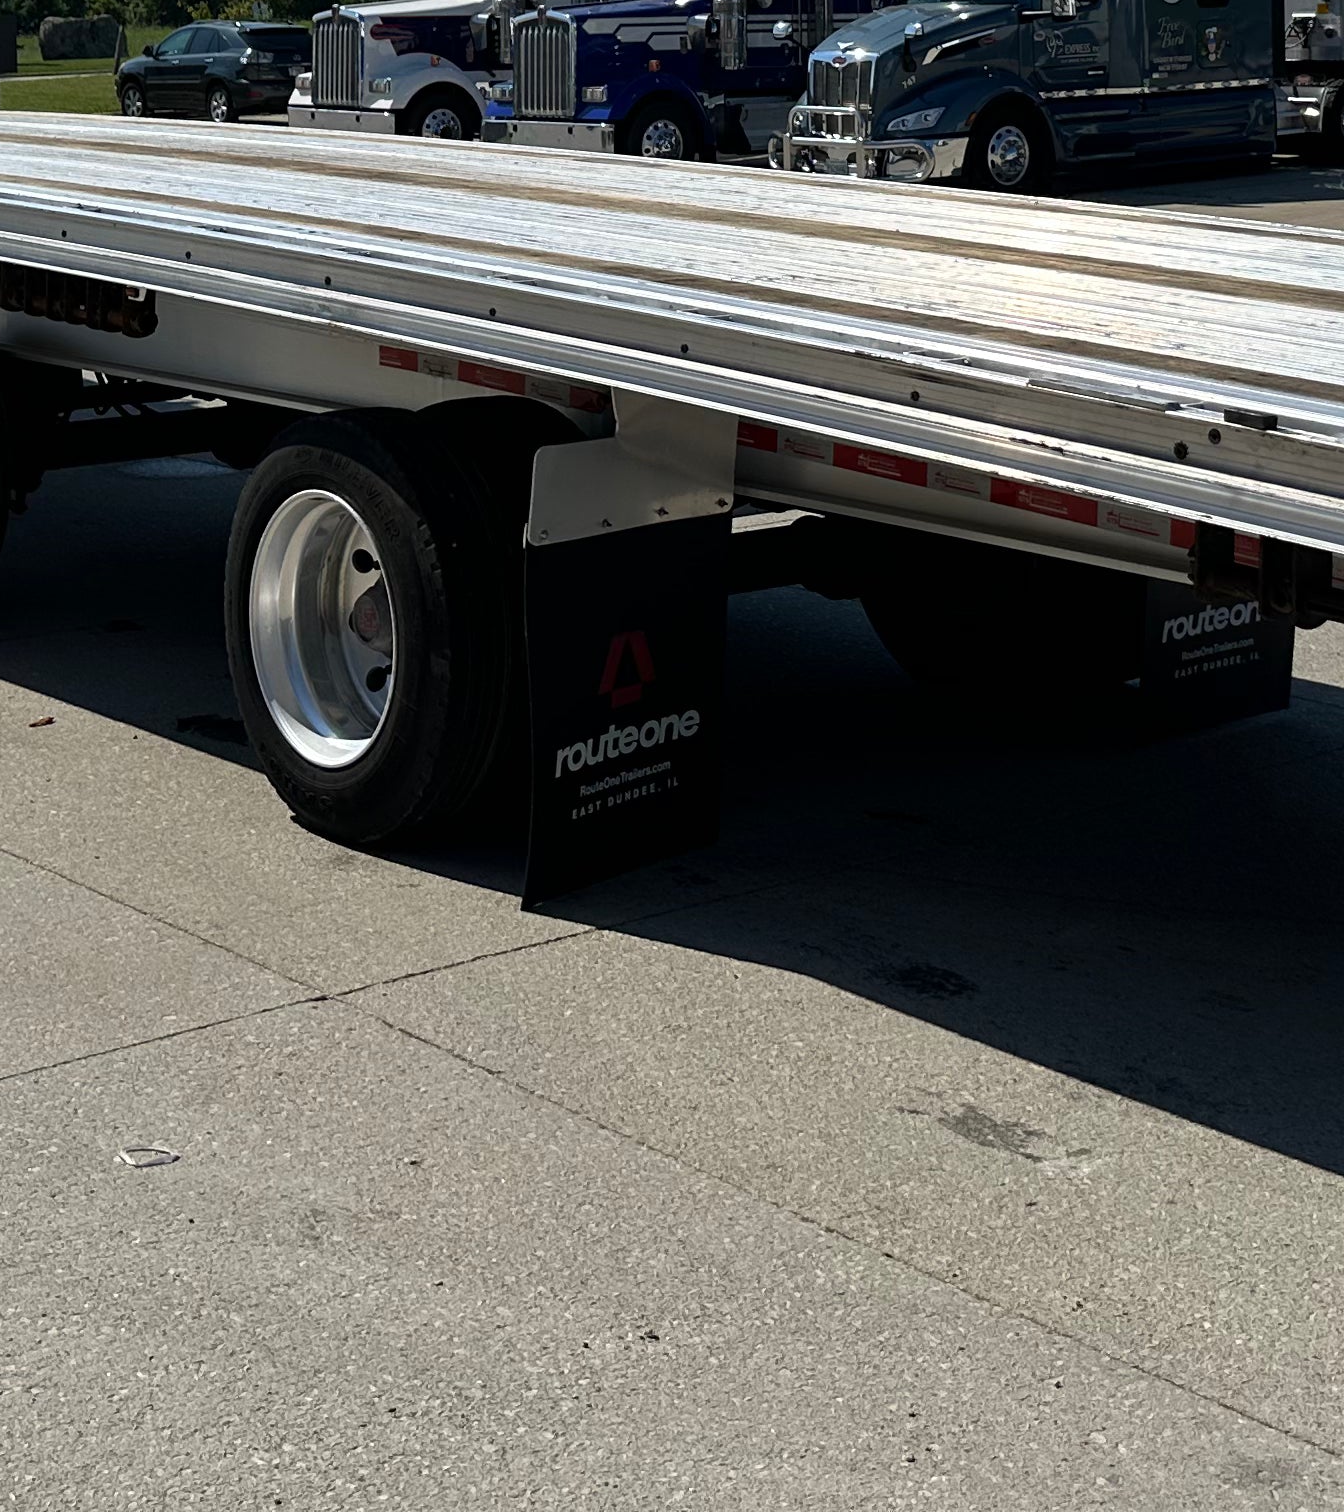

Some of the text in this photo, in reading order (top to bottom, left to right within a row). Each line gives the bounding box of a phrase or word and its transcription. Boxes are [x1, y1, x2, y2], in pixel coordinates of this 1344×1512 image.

[1162, 600, 1261, 643] routeon
[1174, 664, 1198, 679] EAST
[555, 709, 700, 779] routeone
[572, 800, 602, 820] EAST
[667, 776, 679, 789] IL
[580, 761, 671, 798] RouteOneTrailers.com
